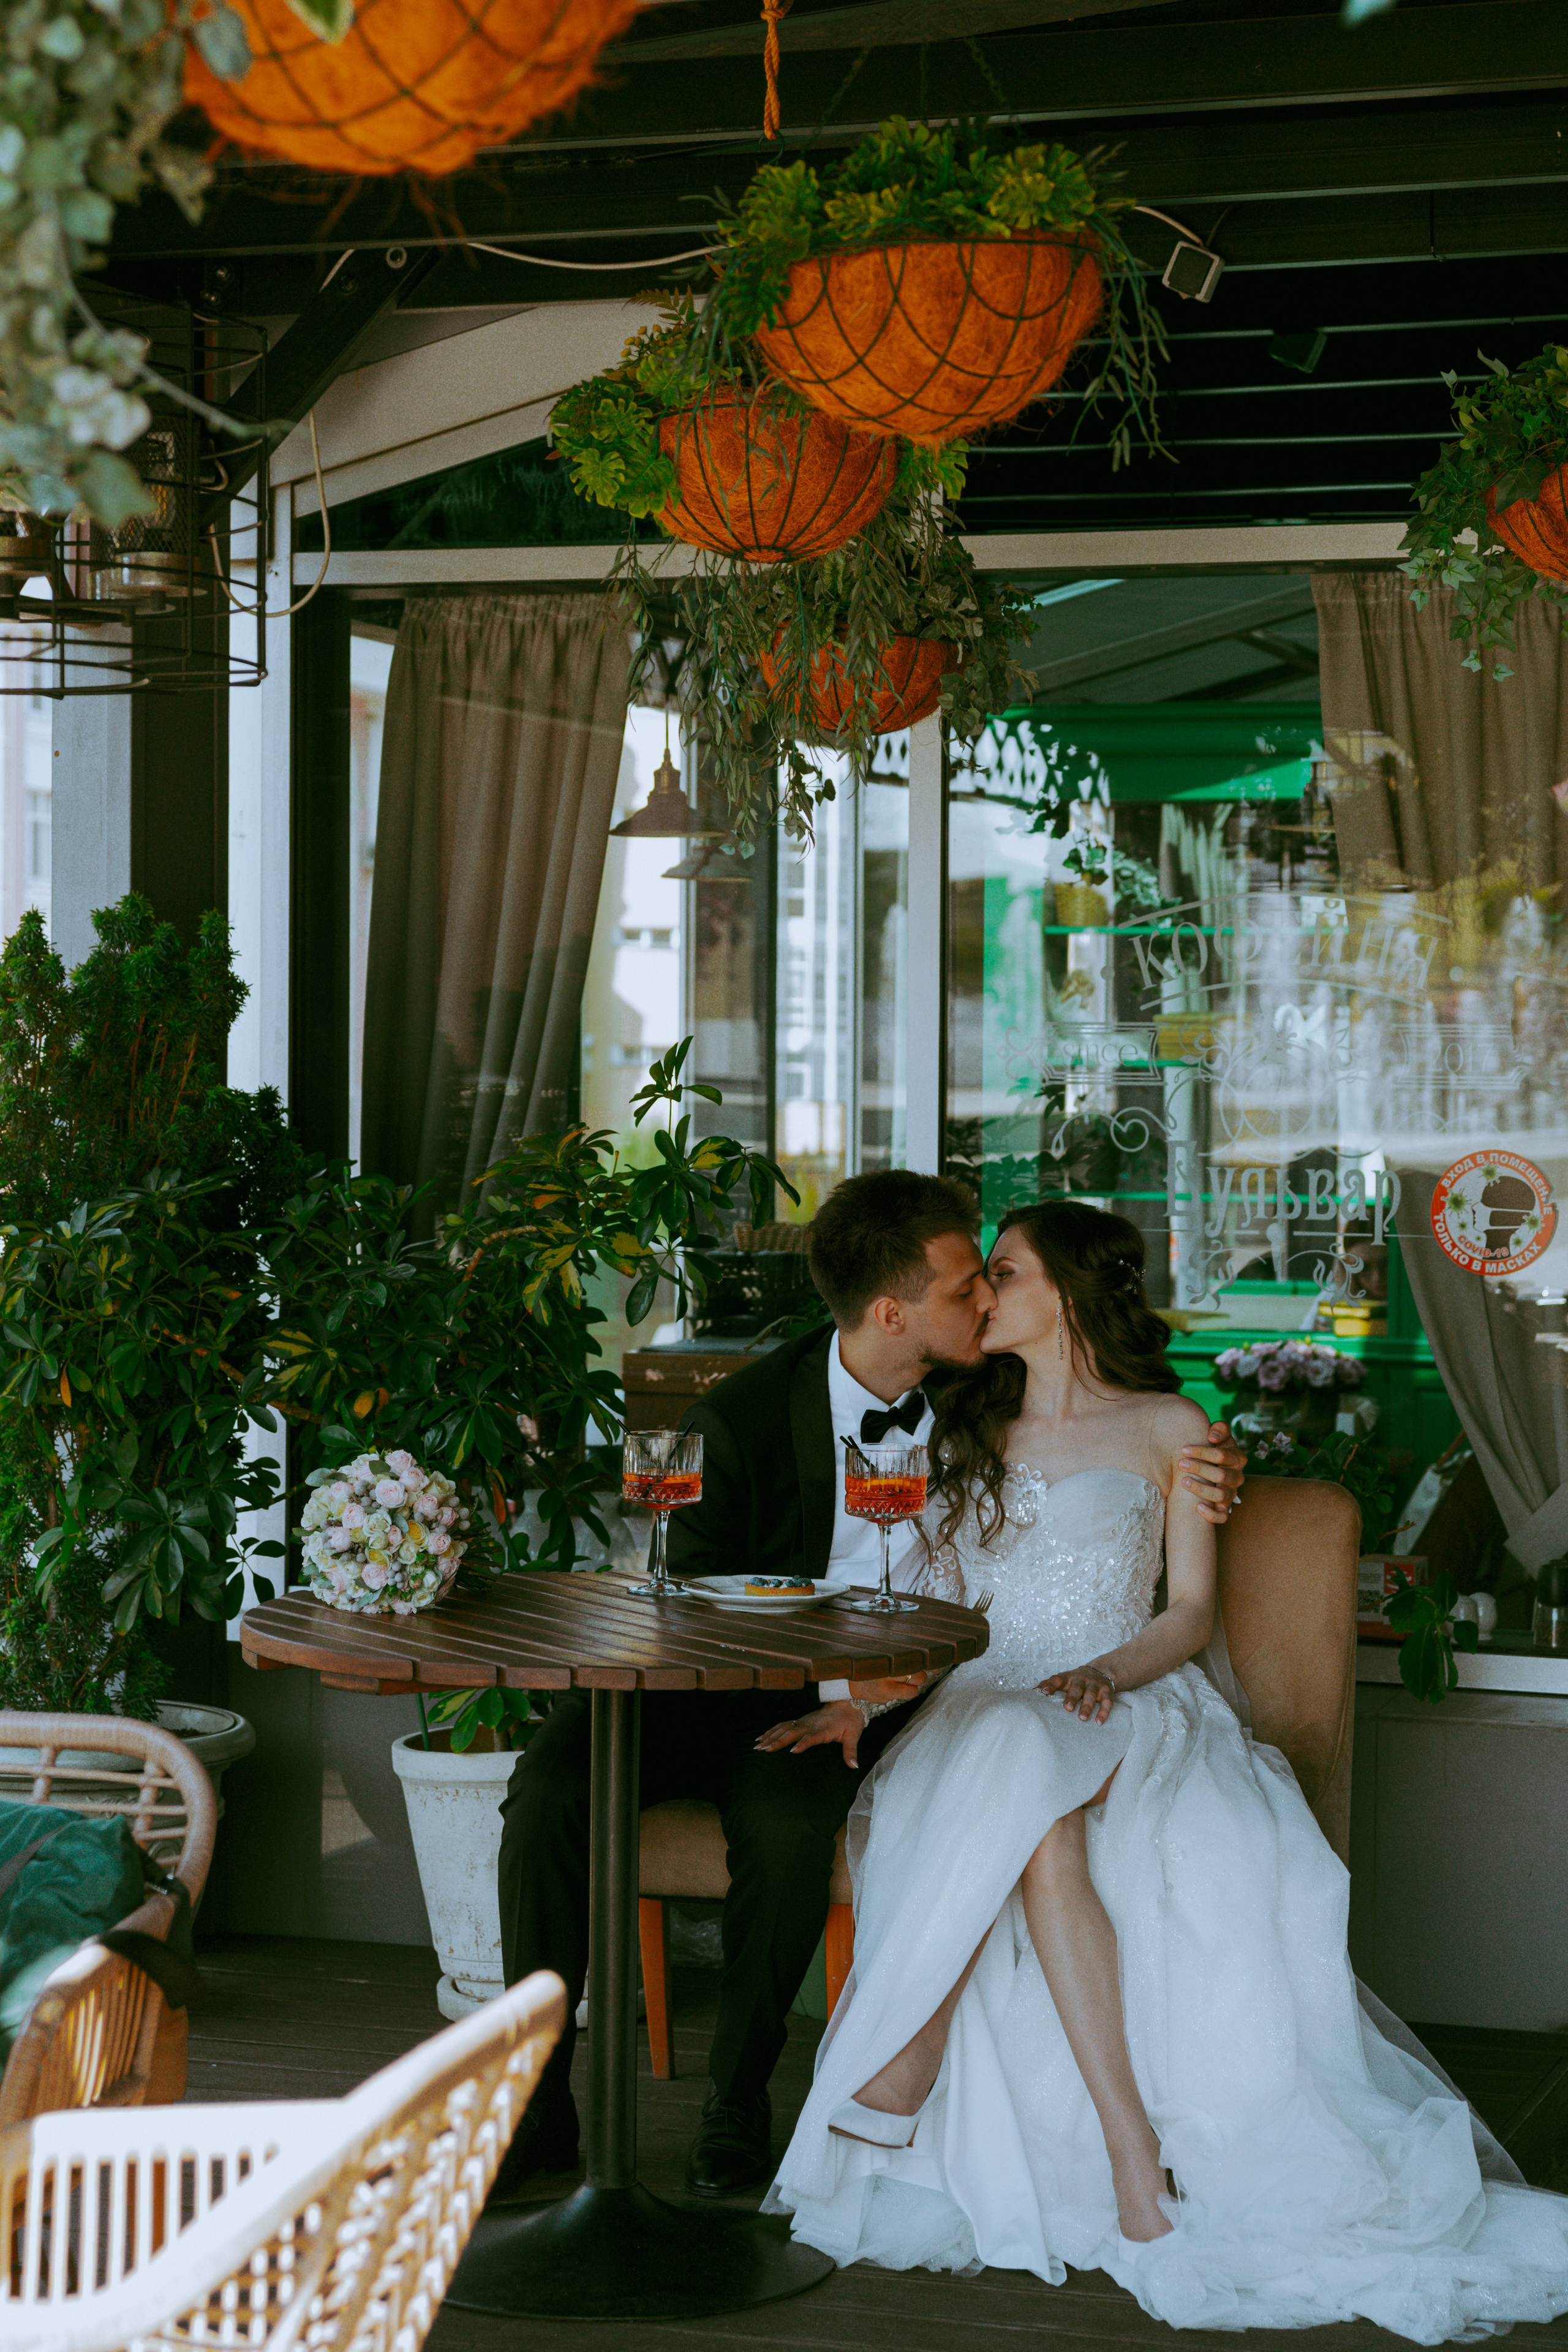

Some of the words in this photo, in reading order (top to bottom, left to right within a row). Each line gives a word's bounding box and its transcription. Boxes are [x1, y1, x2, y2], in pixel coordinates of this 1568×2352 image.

[1063, 1040, 1138, 1066] since
[1441, 1158, 1474, 1188] ВХОД
[1476, 1154, 1485, 1163] В
[1163, 1140, 1401, 1246] Бульвар
[1433, 1213, 1469, 1265] ТОЛЬКО
[1471, 1260, 1482, 1271] В
[1485, 1242, 1542, 1273] МАСКАХ
[1458, 1234, 1509, 1259] COVID-19
